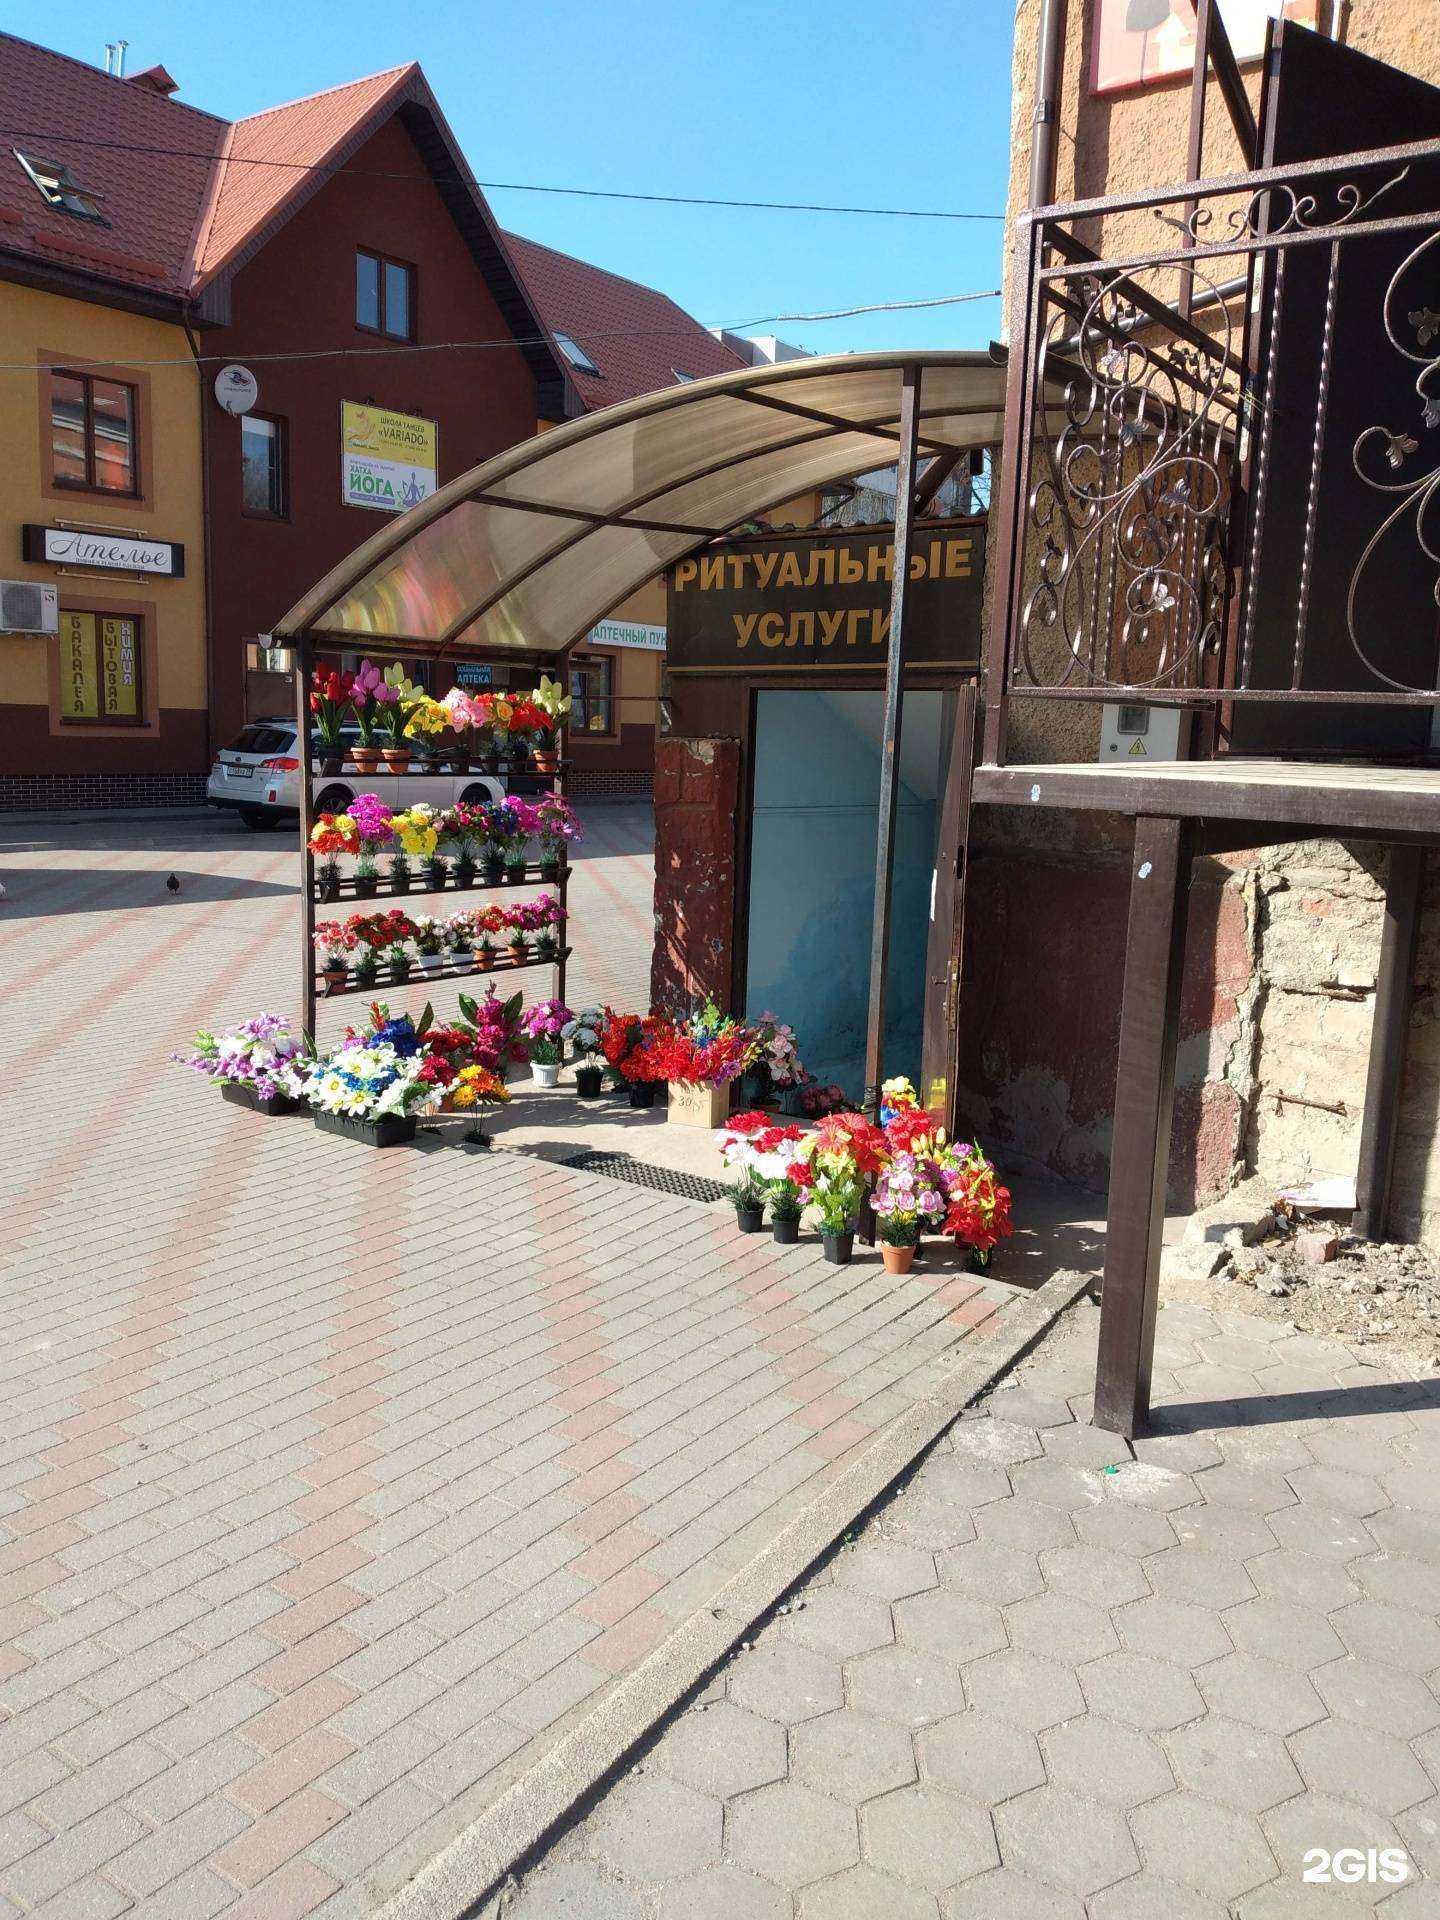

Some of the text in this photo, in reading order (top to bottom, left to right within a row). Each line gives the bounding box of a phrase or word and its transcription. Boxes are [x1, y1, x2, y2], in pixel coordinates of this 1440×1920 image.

[350, 472, 395, 497] ЙОГА
[50, 534, 168, 567] Ателье
[674, 539, 973, 592] РИТУАЛЬНЫЕ
[593, 626, 646, 644] АПТЕЧНЫЙ
[71, 615, 84, 713] БАКАЛЕЯ
[104, 622, 117, 711] БЫТОВАЯ
[457, 674, 490, 684] АПТЕКА
